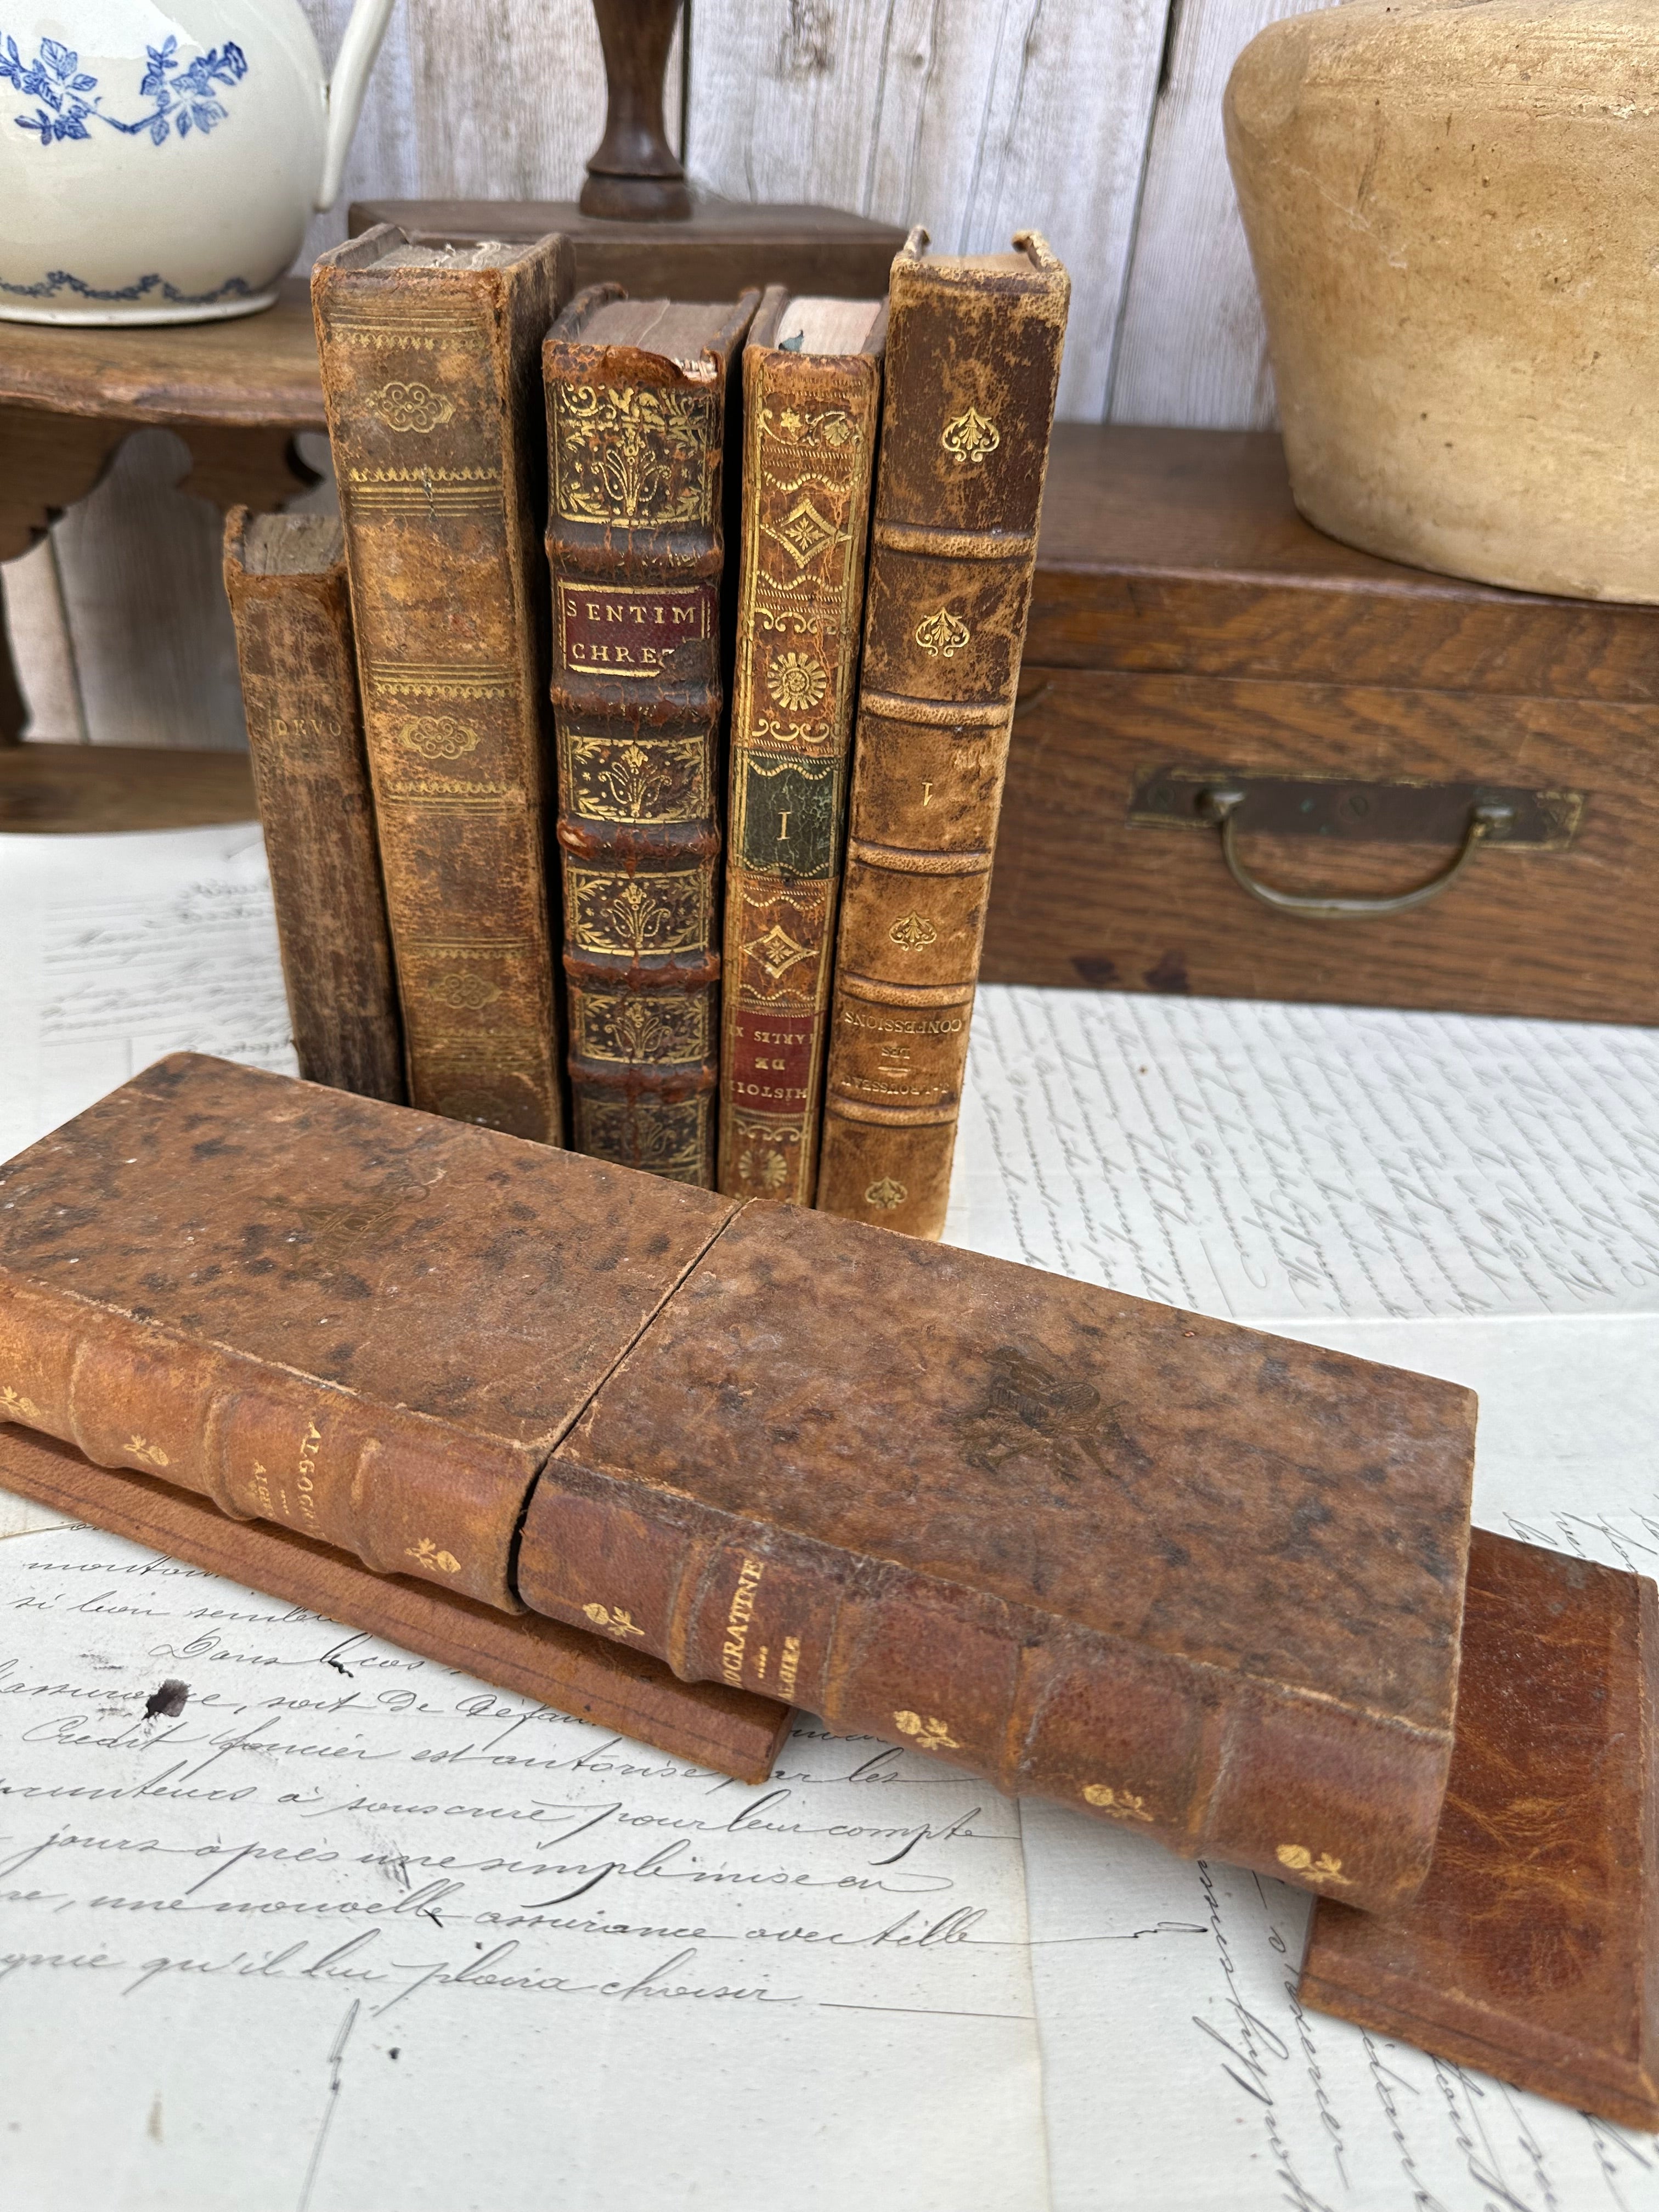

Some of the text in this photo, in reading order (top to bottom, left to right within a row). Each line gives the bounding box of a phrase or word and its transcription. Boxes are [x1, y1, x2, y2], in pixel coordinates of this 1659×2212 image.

[567, 600, 696, 624] SENTIM
[844, 1011, 962, 1034] CONFESSIONS
[755, 1057, 786, 1070] DE
[881, 1046, 911, 1060] LES
[730, 1080, 809, 1099] HISTOI
[842, 1075, 920, 1096] ROUSSEAU
[723, 1559, 764, 1689] OCRATINE
[828, 1807, 981, 1865] compte
[476, 1909, 713, 1939] assurance
